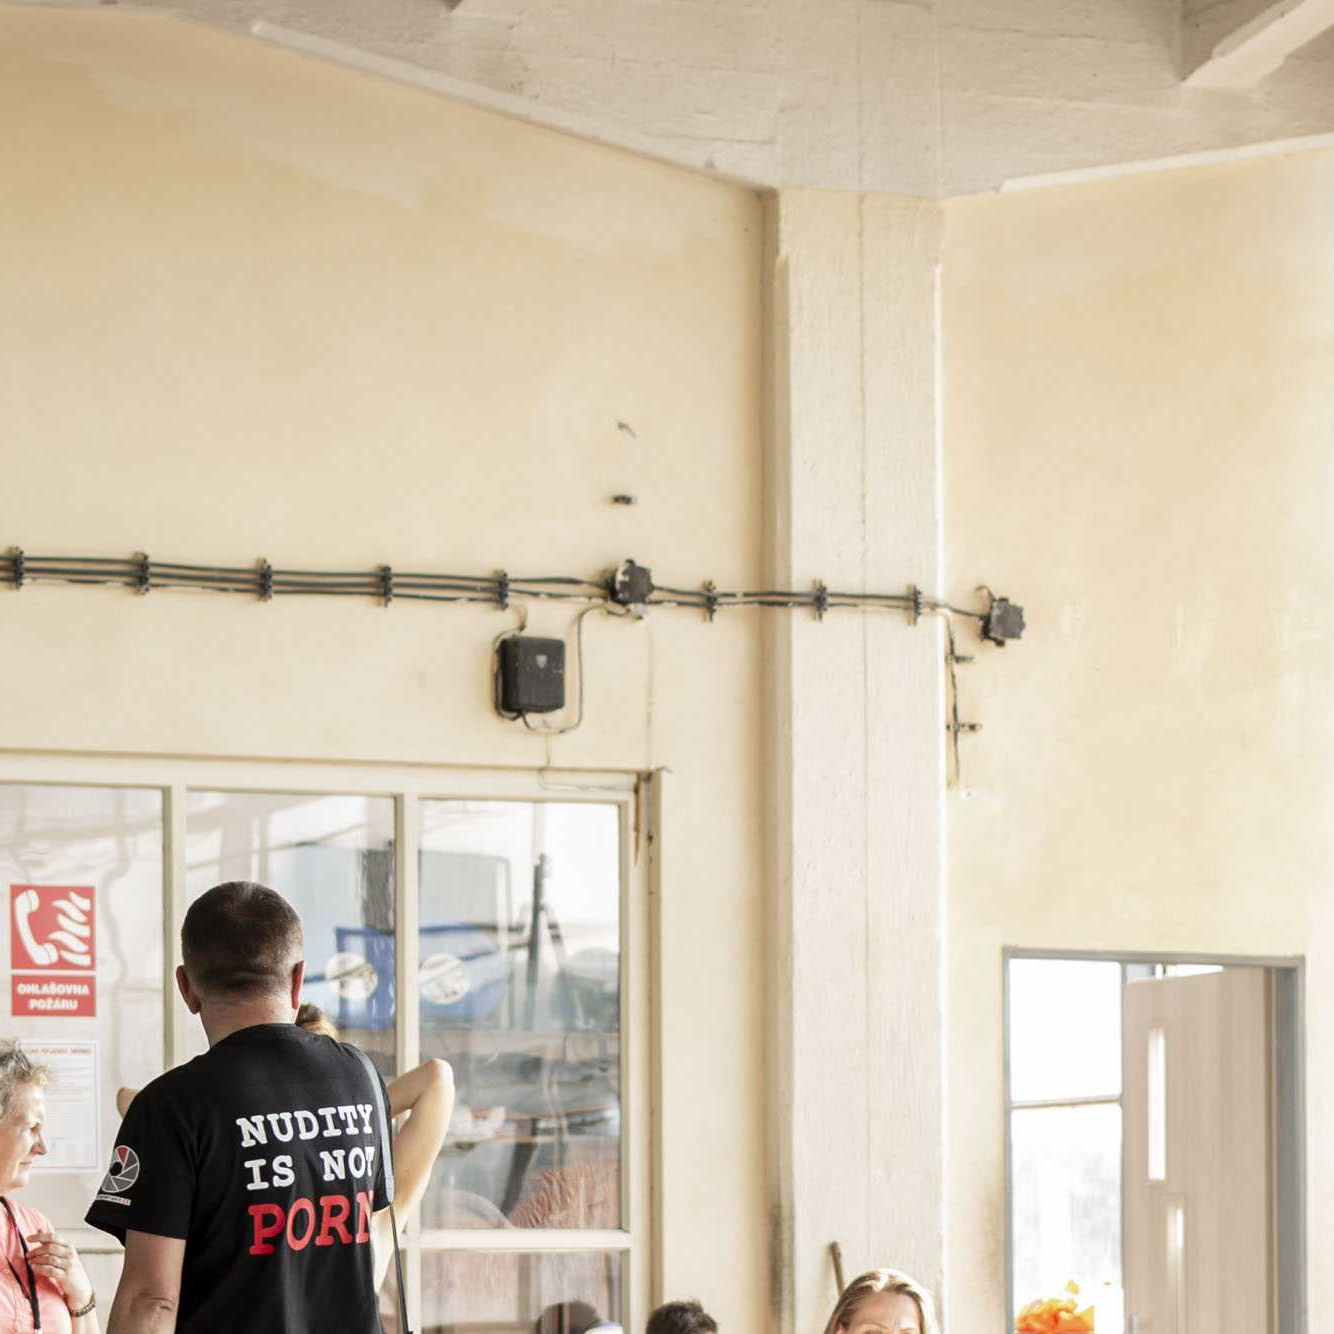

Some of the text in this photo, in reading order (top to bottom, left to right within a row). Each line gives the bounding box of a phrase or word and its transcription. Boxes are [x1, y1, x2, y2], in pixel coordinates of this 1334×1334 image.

[235, 1103, 373, 1148] NUDITY
[244, 1146, 375, 1191] IS NOT
